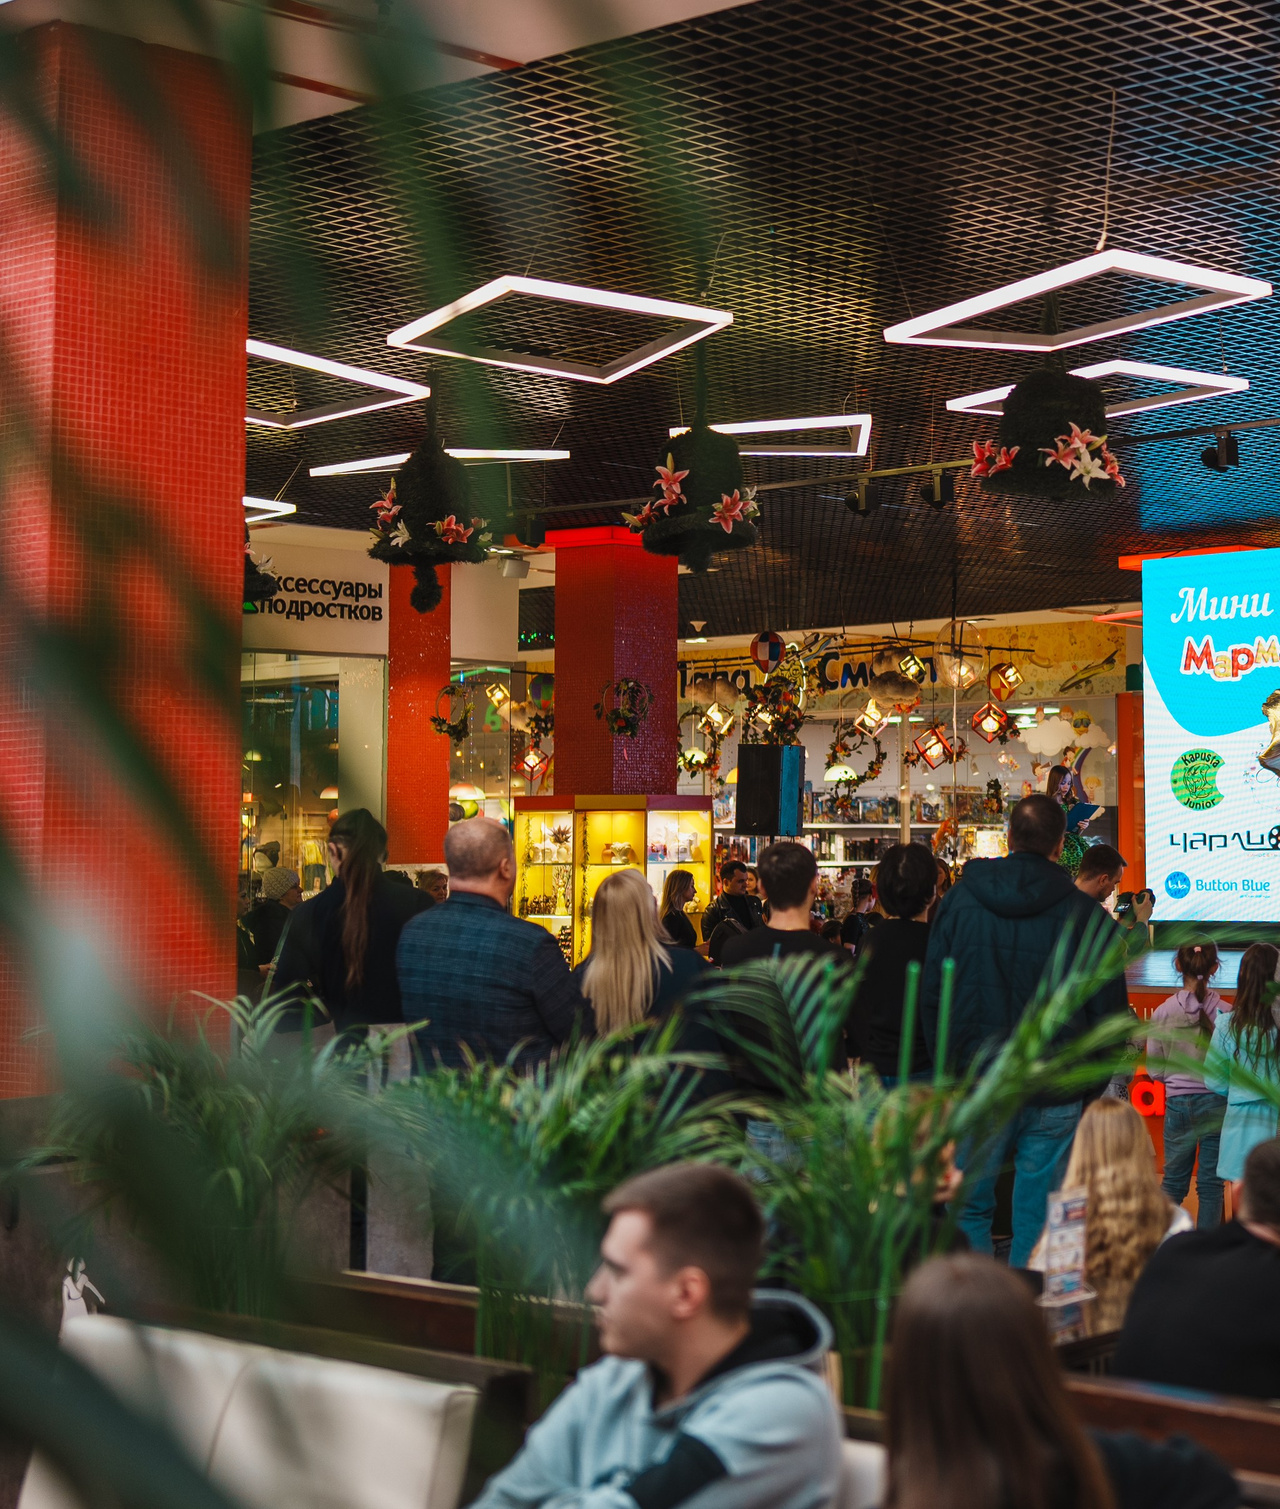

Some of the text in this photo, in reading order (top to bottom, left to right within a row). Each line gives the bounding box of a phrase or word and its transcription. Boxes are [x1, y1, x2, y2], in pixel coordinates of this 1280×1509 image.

[1170, 586, 1274, 624] Мини
[1181, 752, 1220, 768] Kapusta
[1184, 797, 1216, 810] Junior
[1196, 879, 1270, 892] Button Blue
